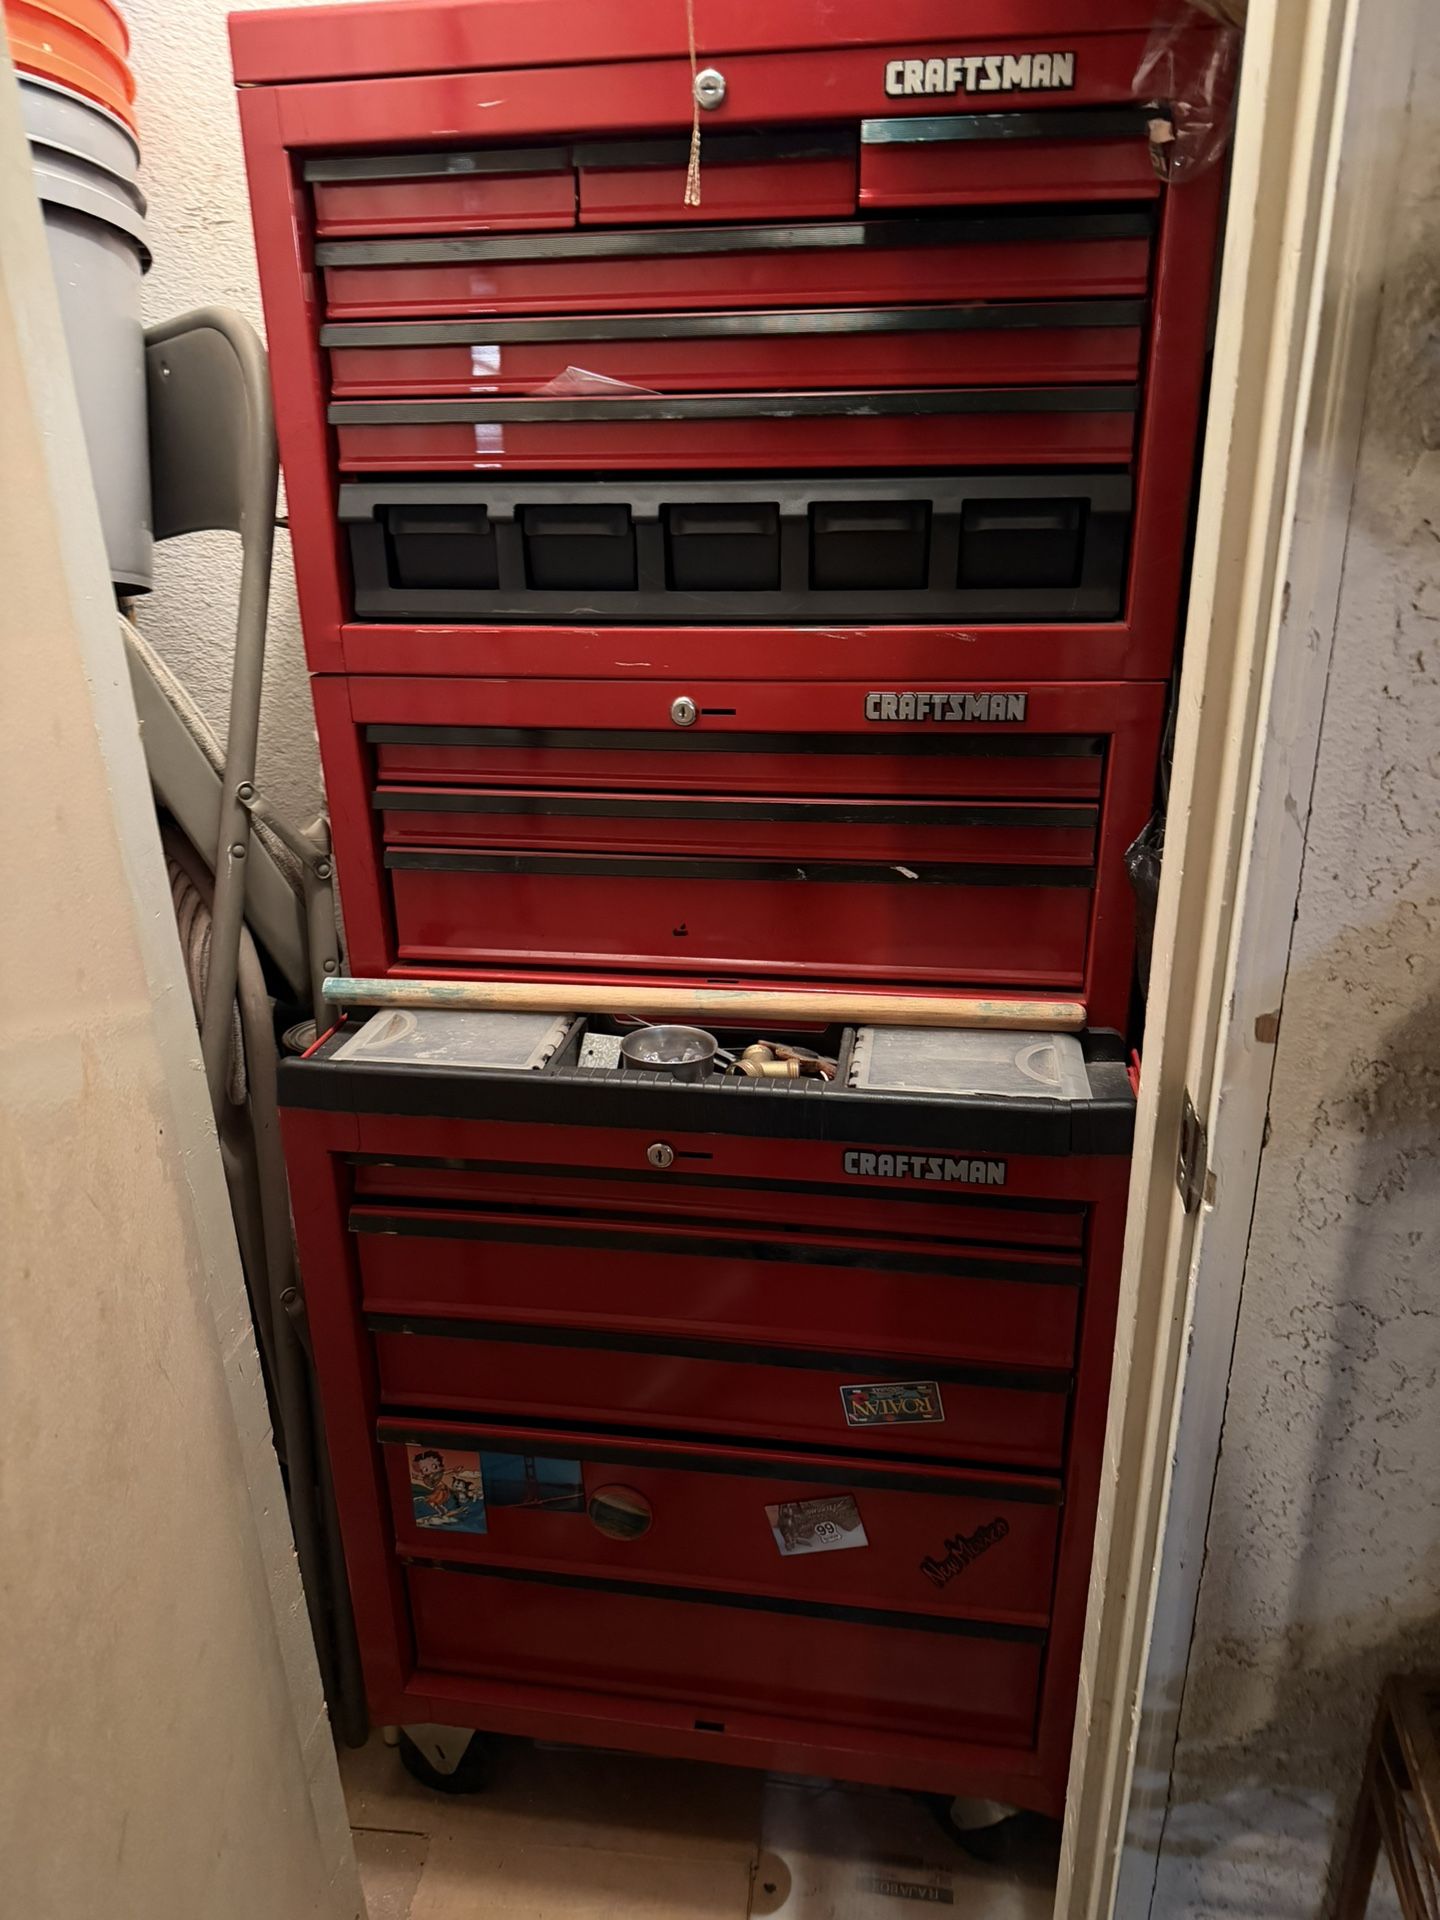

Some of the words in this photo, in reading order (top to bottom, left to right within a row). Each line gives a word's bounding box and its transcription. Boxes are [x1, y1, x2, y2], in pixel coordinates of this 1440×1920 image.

[885, 52, 1075, 97] CRAFTSMAN
[865, 690, 1028, 722] CRAFTSMAN
[843, 1151, 1006, 1186] CRAFTSMAN
[851, 1397, 934, 1416] ROATAN
[816, 1522, 835, 1536] 66
